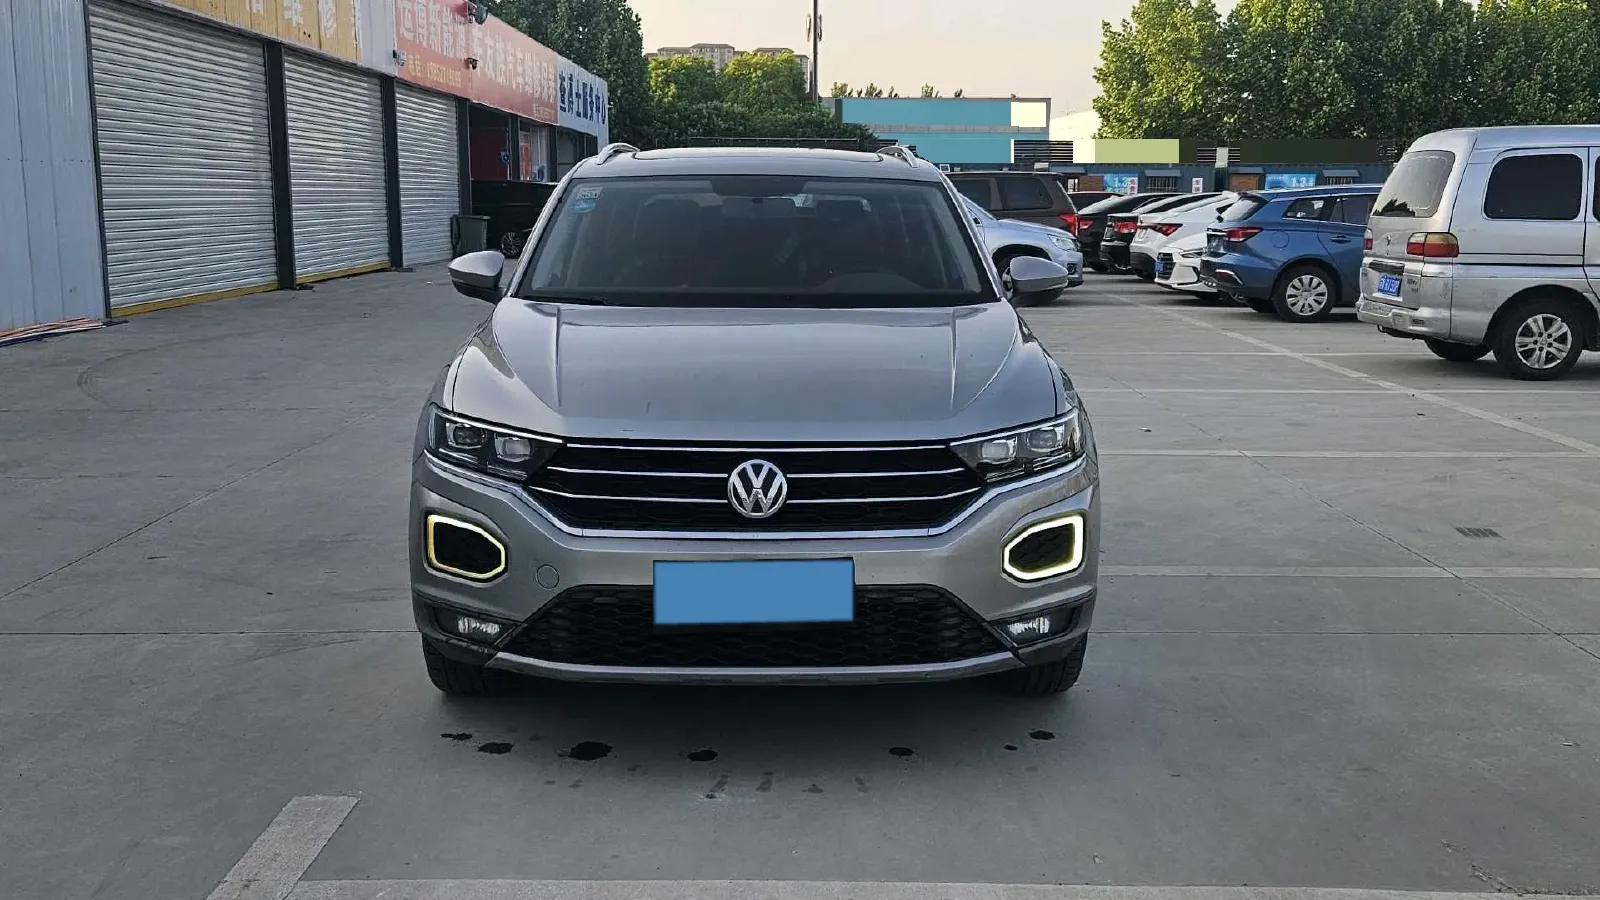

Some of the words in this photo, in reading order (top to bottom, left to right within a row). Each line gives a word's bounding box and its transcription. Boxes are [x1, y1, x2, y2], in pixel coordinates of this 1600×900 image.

[559, 69, 606, 125] 查博士服务中心
